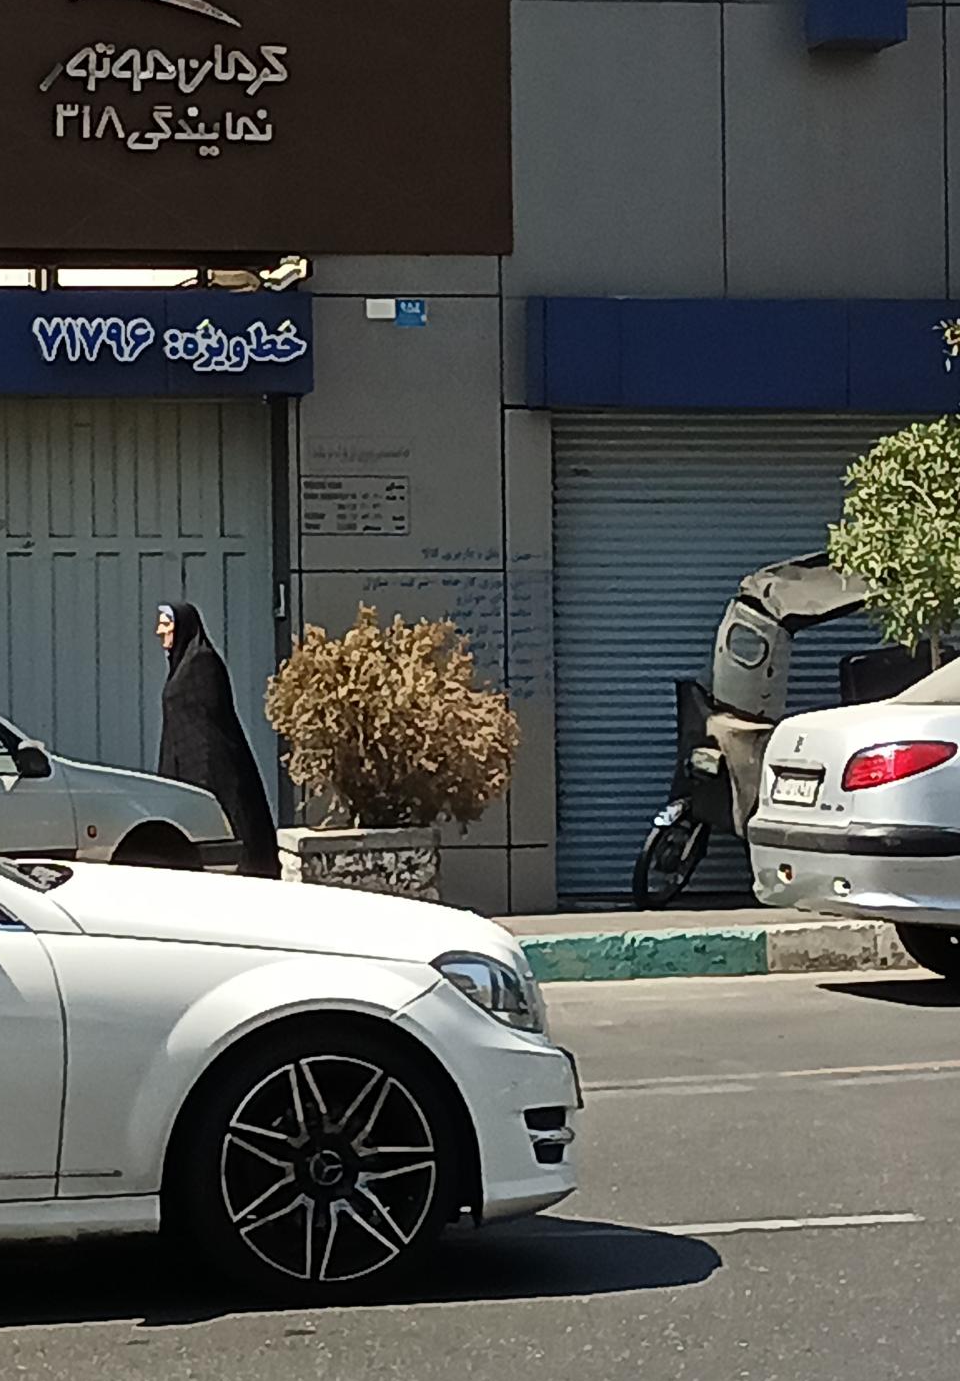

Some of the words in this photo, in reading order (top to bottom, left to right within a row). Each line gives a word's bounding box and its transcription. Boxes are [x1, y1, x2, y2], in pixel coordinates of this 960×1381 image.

[39, 42, 177, 93] موتور
[177, 44, 288, 96] کرمان
[55, 104, 125, 139] ۳۱۸
[126, 106, 273, 157] نمایندگی
[32, 317, 156, 362] ۷۱۷۹۶
[247, 320, 308, 363] خط
